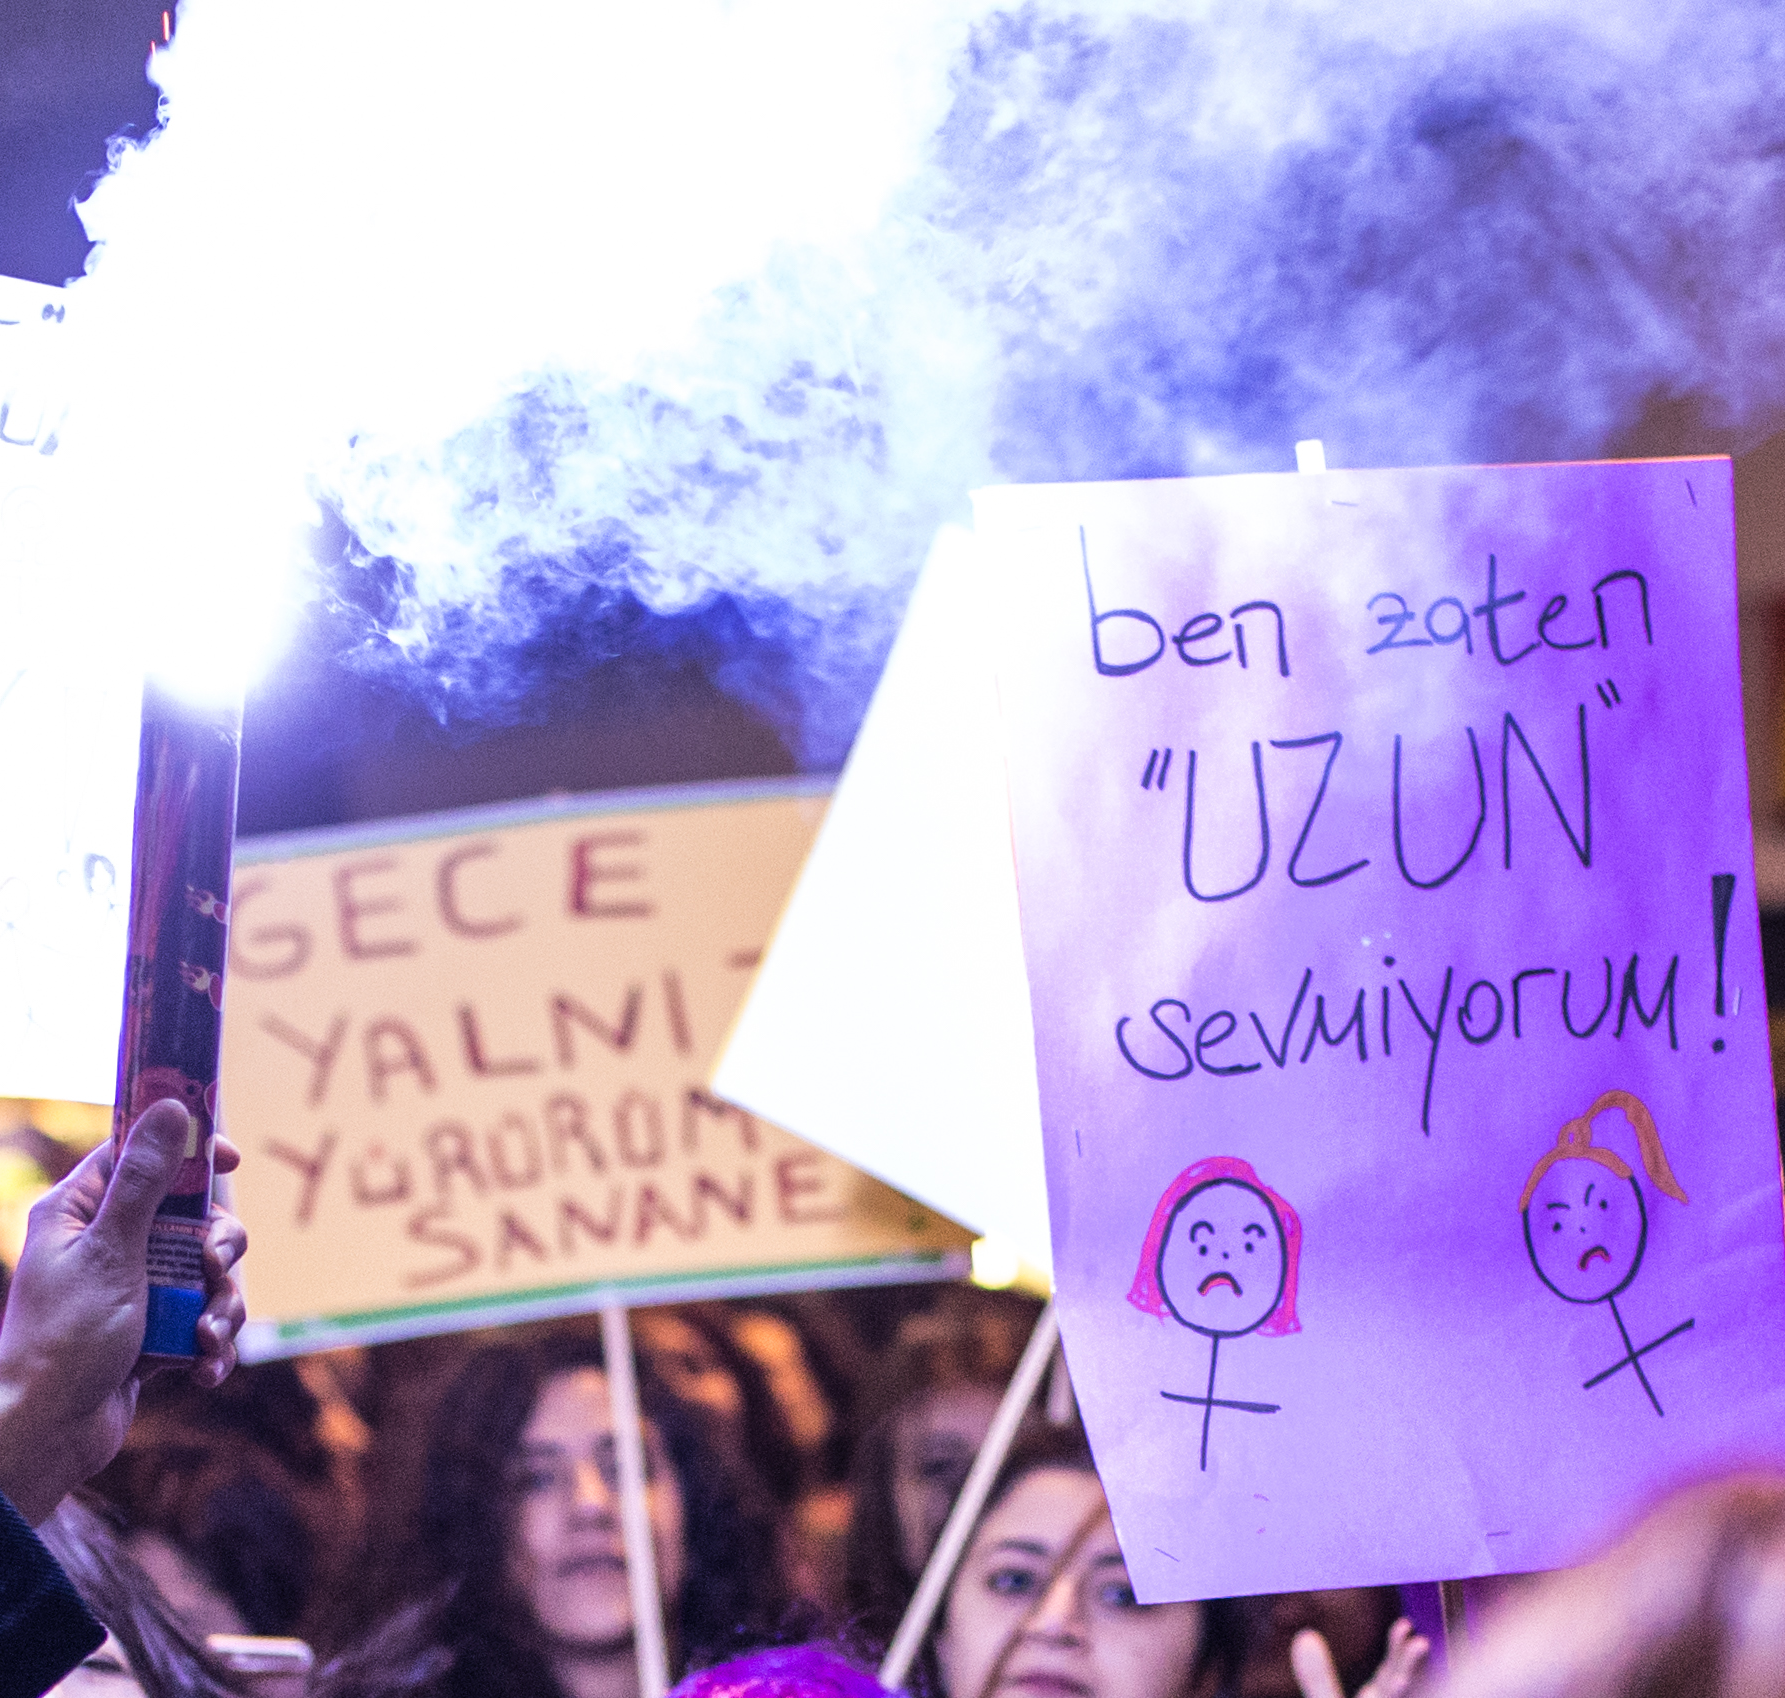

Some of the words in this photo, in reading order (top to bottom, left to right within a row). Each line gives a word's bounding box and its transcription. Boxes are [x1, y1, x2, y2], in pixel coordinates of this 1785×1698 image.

[1079, 525, 1291, 677] ben
[1365, 553, 1654, 666] zaten
[227, 830, 655, 980] GECE
[260, 947, 764, 1106] YALNI
